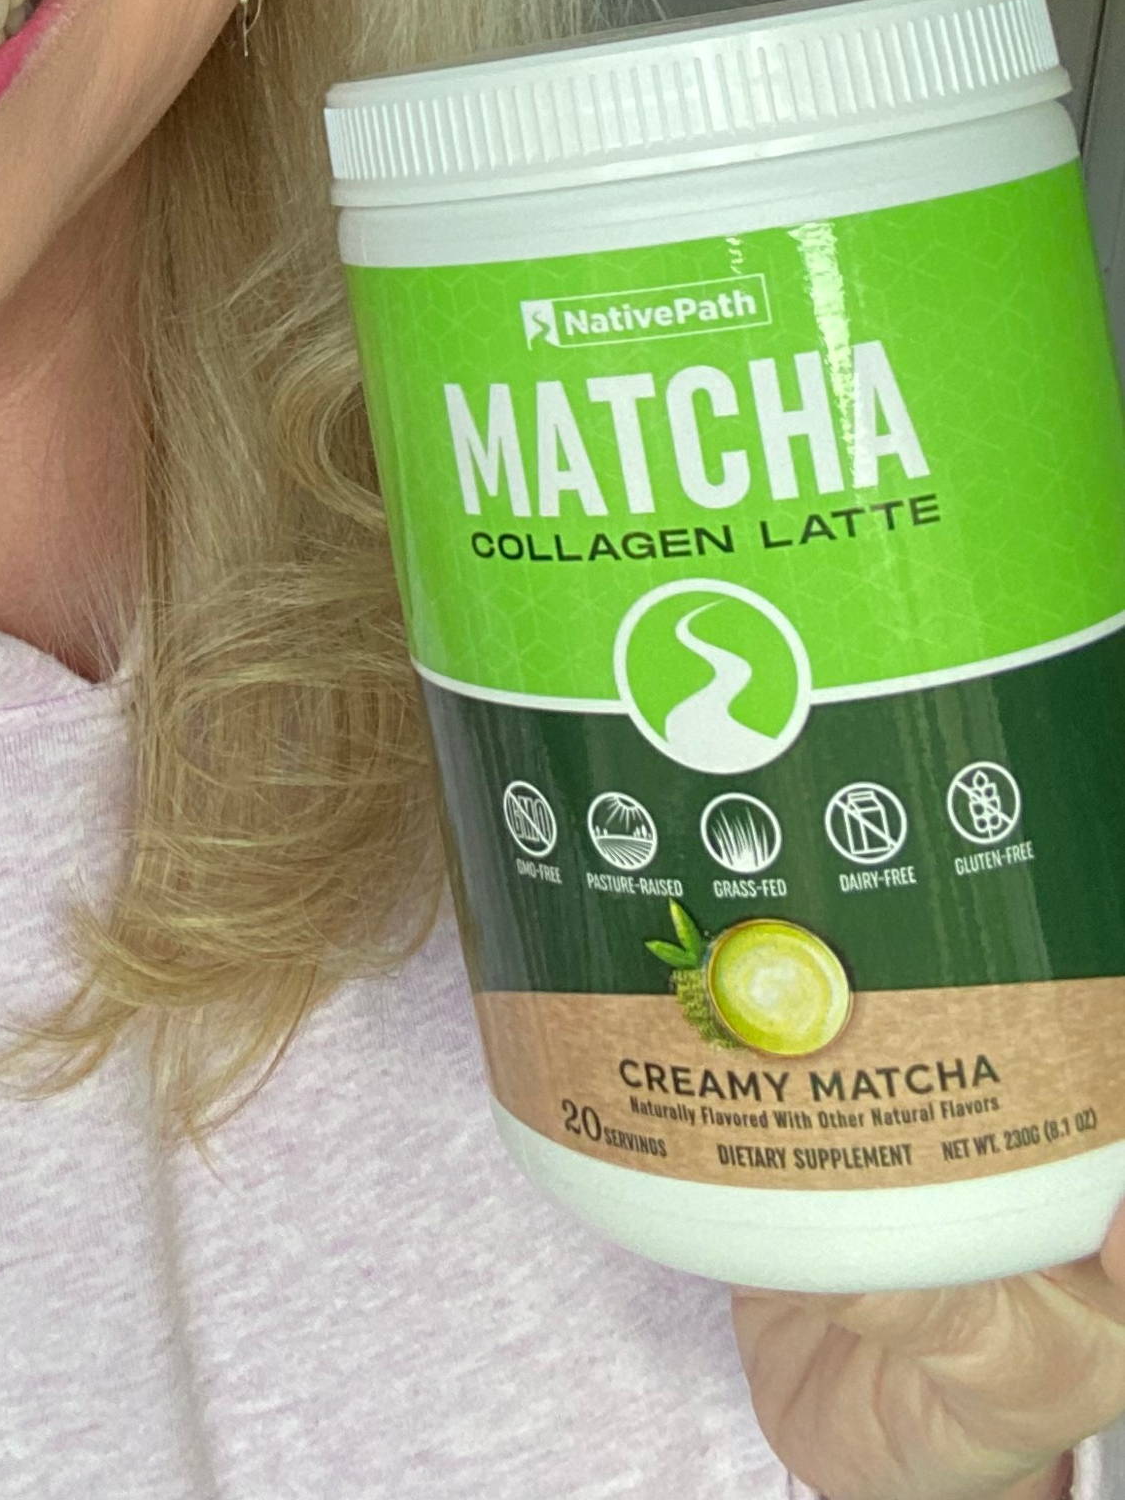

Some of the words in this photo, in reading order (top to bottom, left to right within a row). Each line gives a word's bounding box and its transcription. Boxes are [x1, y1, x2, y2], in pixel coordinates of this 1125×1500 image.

[561, 289, 759, 337] NativePath
[443, 339, 931, 518] MATCHA
[471, 524, 735, 562] COLLAGEN
[759, 493, 942, 550] LATTE
[515, 857, 563, 885] GMO-FREE
[954, 840, 1035, 876] GLUTEN-FREE
[586, 872, 684, 898] PASTURE-RAISED
[712, 878, 788, 899] GRASS-FED
[838, 865, 918, 893] DAIRY-FREE
[618, 1058, 790, 1103] CREAMY
[807, 1053, 1001, 1102] MATCHA
[561, 1098, 603, 1142] 20
[603, 1126, 668, 1159] SERVINGS
[629, 1095, 696, 1127] Naturally
[700, 1106, 768, 1129] Flavored
[773, 1110, 813, 1130] With
[817, 1108, 865, 1129] Other
[870, 1102, 936, 1127] Natural
[940, 1095, 1001, 1119] Flavors
[940, 1137, 971, 1162] NET
[973, 1132, 1001, 1156] WT.
[1003, 1124, 1041, 1151] 230G
[1043, 1116, 1071, 1144] (8.1
[1075, 1106, 1099, 1132] OZ)
[716, 1143, 787, 1169] DIETARY
[792, 1142, 913, 1170] SUPPLEMENT
